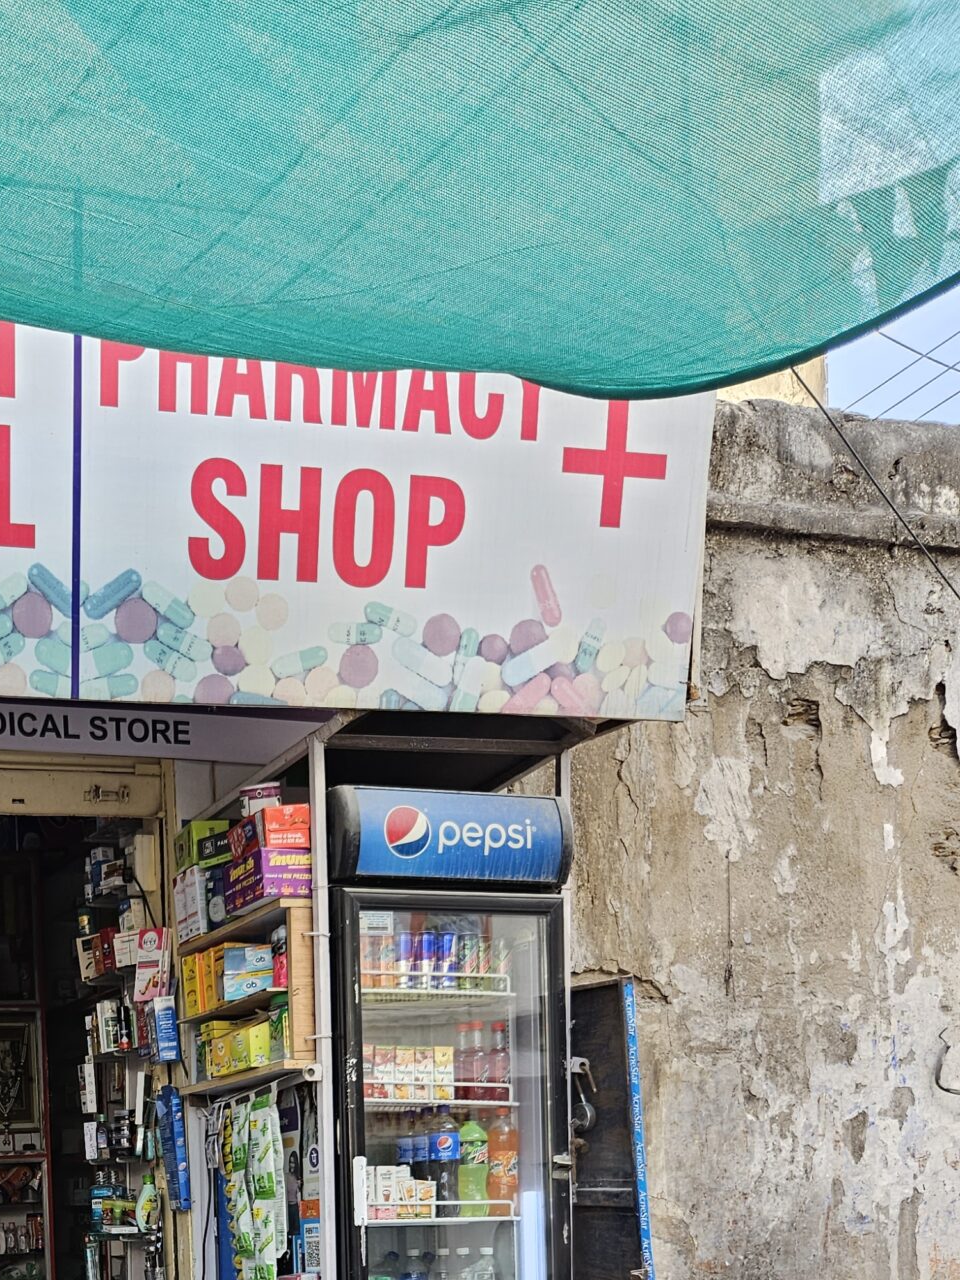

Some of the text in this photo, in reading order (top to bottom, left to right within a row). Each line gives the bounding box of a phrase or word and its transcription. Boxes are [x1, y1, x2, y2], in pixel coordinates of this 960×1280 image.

[187, 458, 466, 589] SHOP
[89, 716, 191, 746] STORE
[437, 818, 533, 856] pepsi
